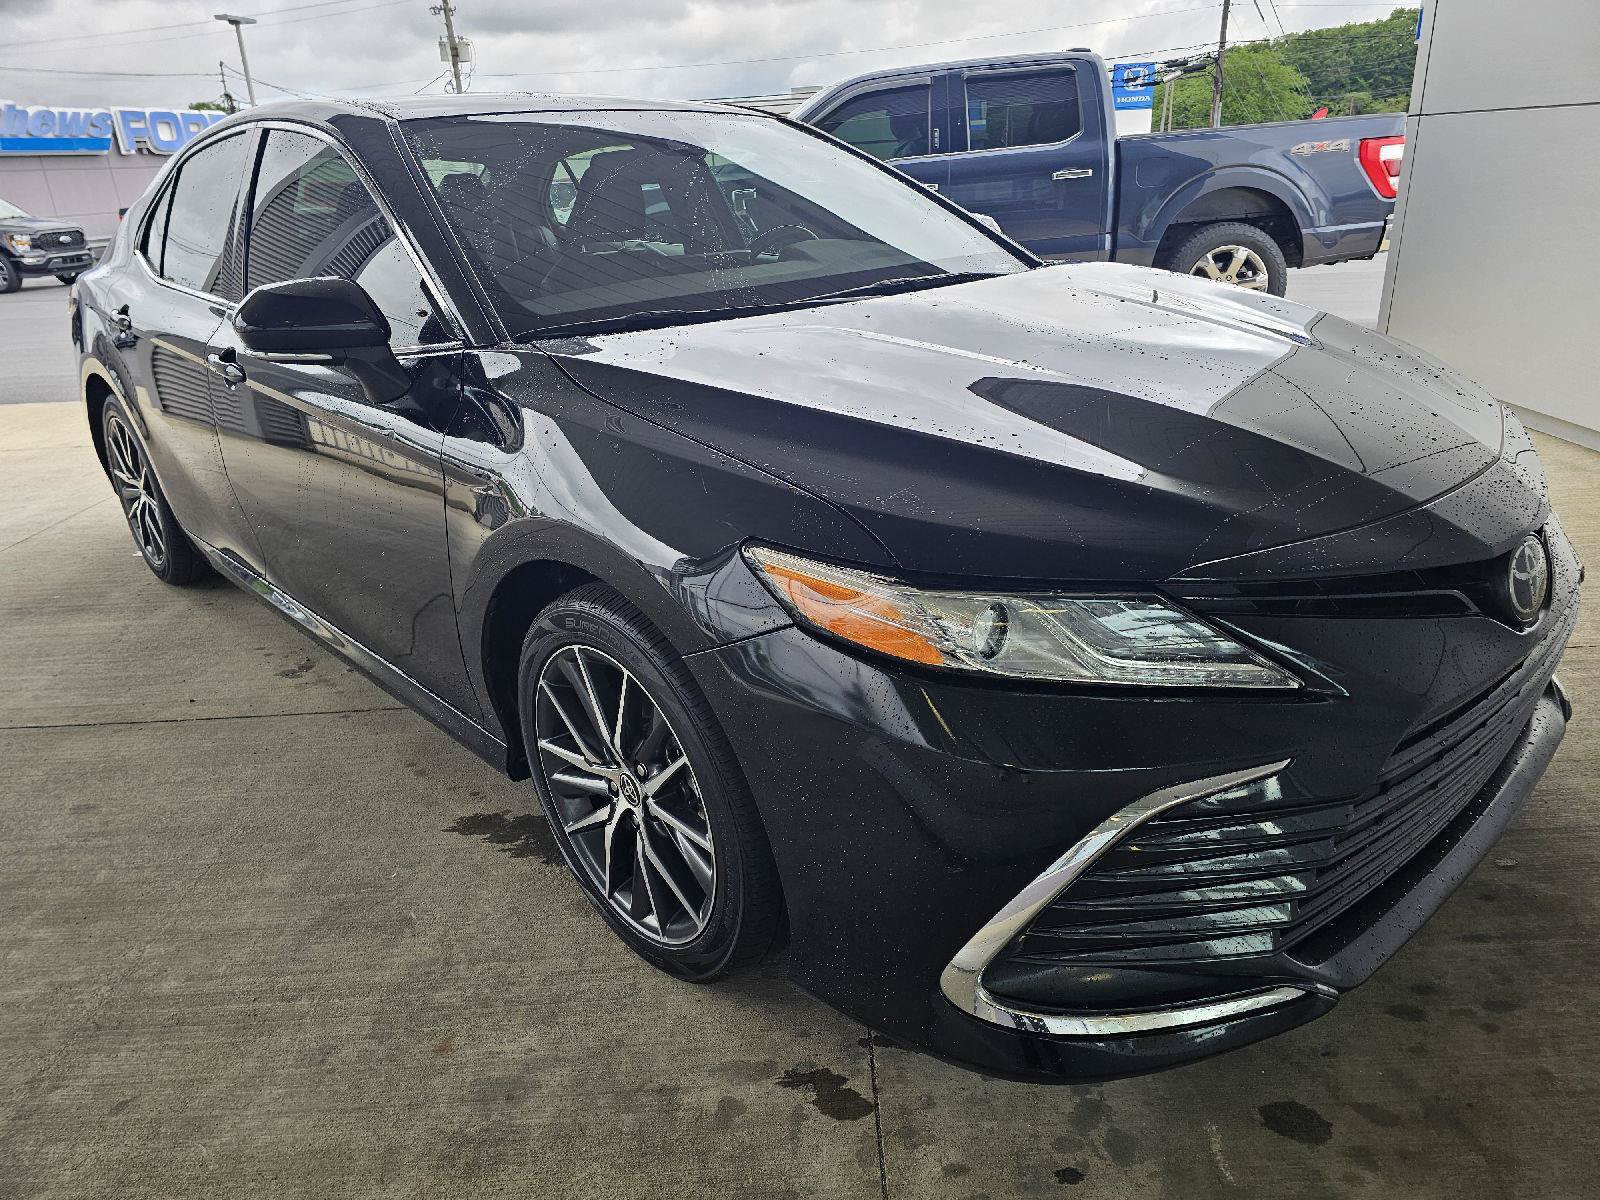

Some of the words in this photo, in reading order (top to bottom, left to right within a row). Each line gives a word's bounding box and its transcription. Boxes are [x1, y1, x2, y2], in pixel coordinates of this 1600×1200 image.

[1116, 95, 1151, 103] HONDA
[0, 102, 113, 137] hews
[114, 108, 226, 154] FOR
